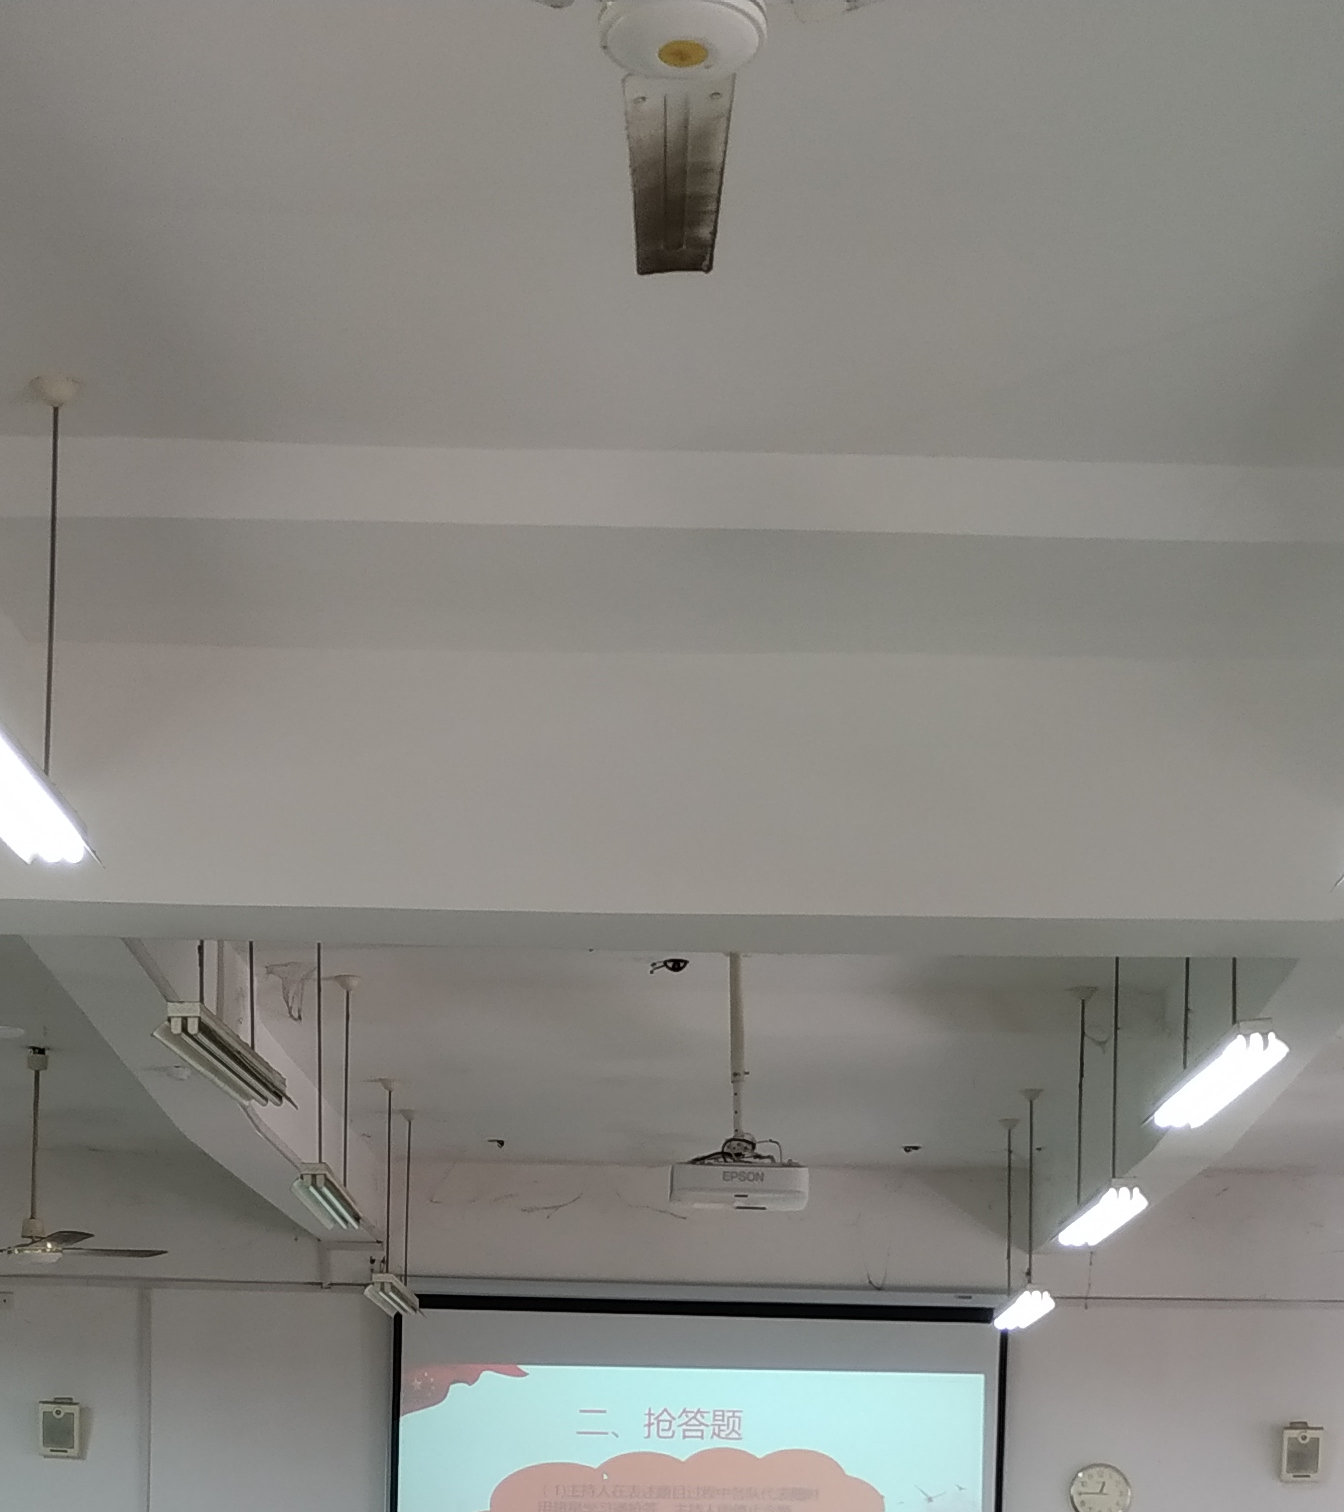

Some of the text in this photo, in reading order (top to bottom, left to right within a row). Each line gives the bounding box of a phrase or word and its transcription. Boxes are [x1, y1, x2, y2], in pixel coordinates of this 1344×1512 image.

[722, 1171, 764, 1182] EPSON
[576, 1407, 744, 1441] 二、抢答题
